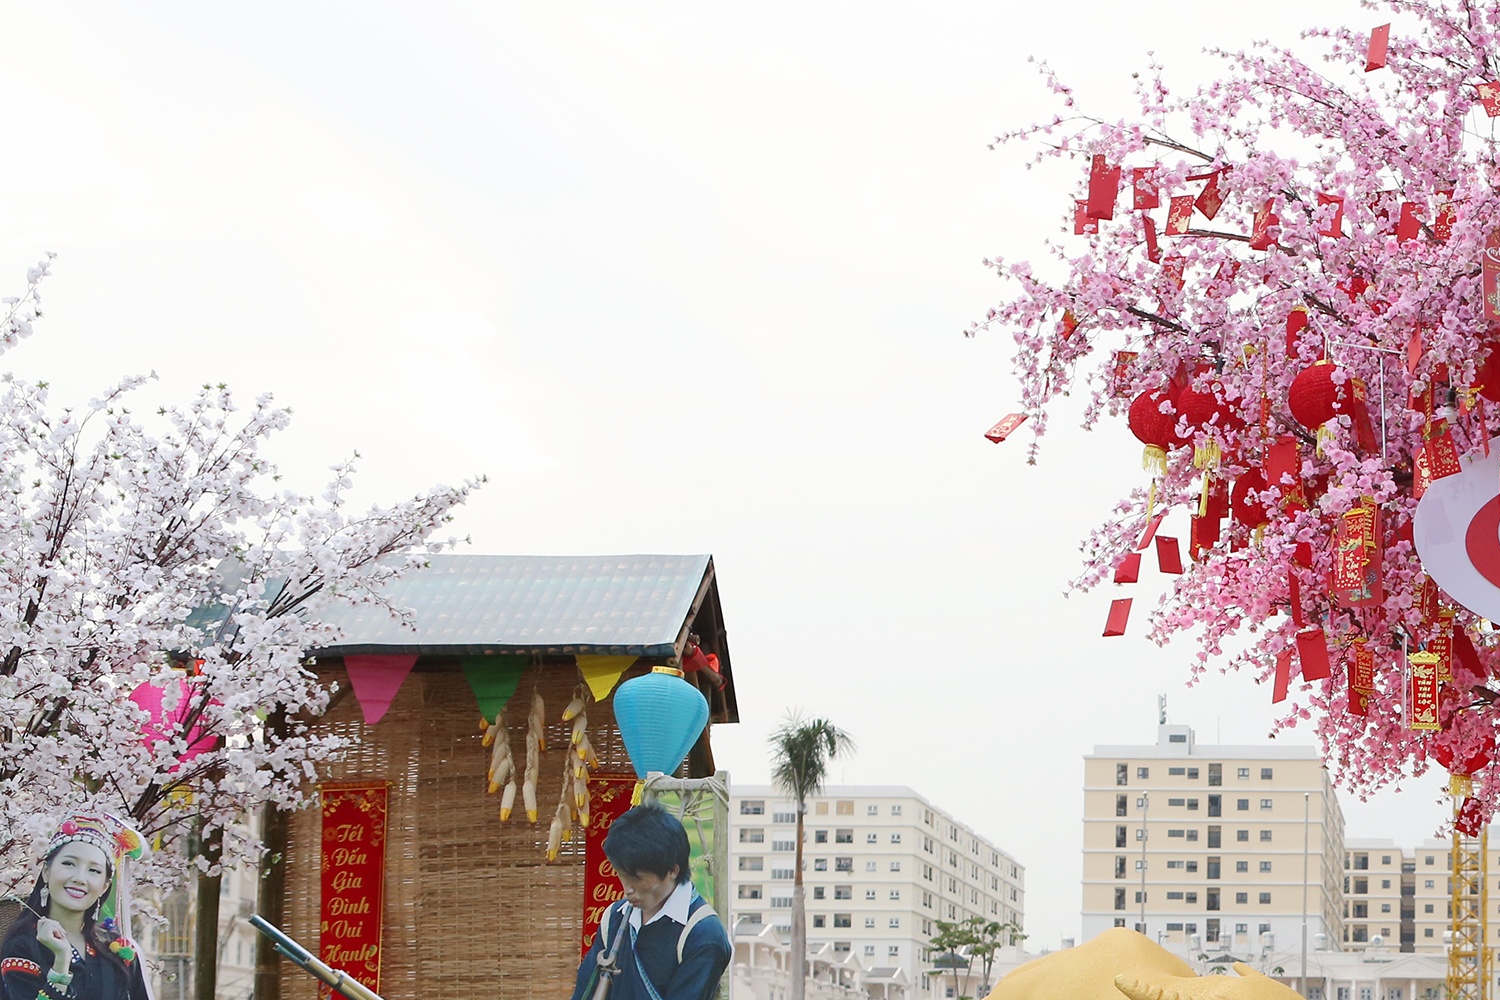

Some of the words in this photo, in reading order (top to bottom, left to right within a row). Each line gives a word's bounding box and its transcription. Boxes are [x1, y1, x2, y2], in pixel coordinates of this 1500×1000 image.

[336, 823, 364, 844] Tết
[331, 847, 368, 867] Đến
[331, 871, 362, 894] Gia
[327, 896, 371, 917] Đình
[331, 919, 363, 939] Vui
[324, 943, 373, 967] Hạnh
